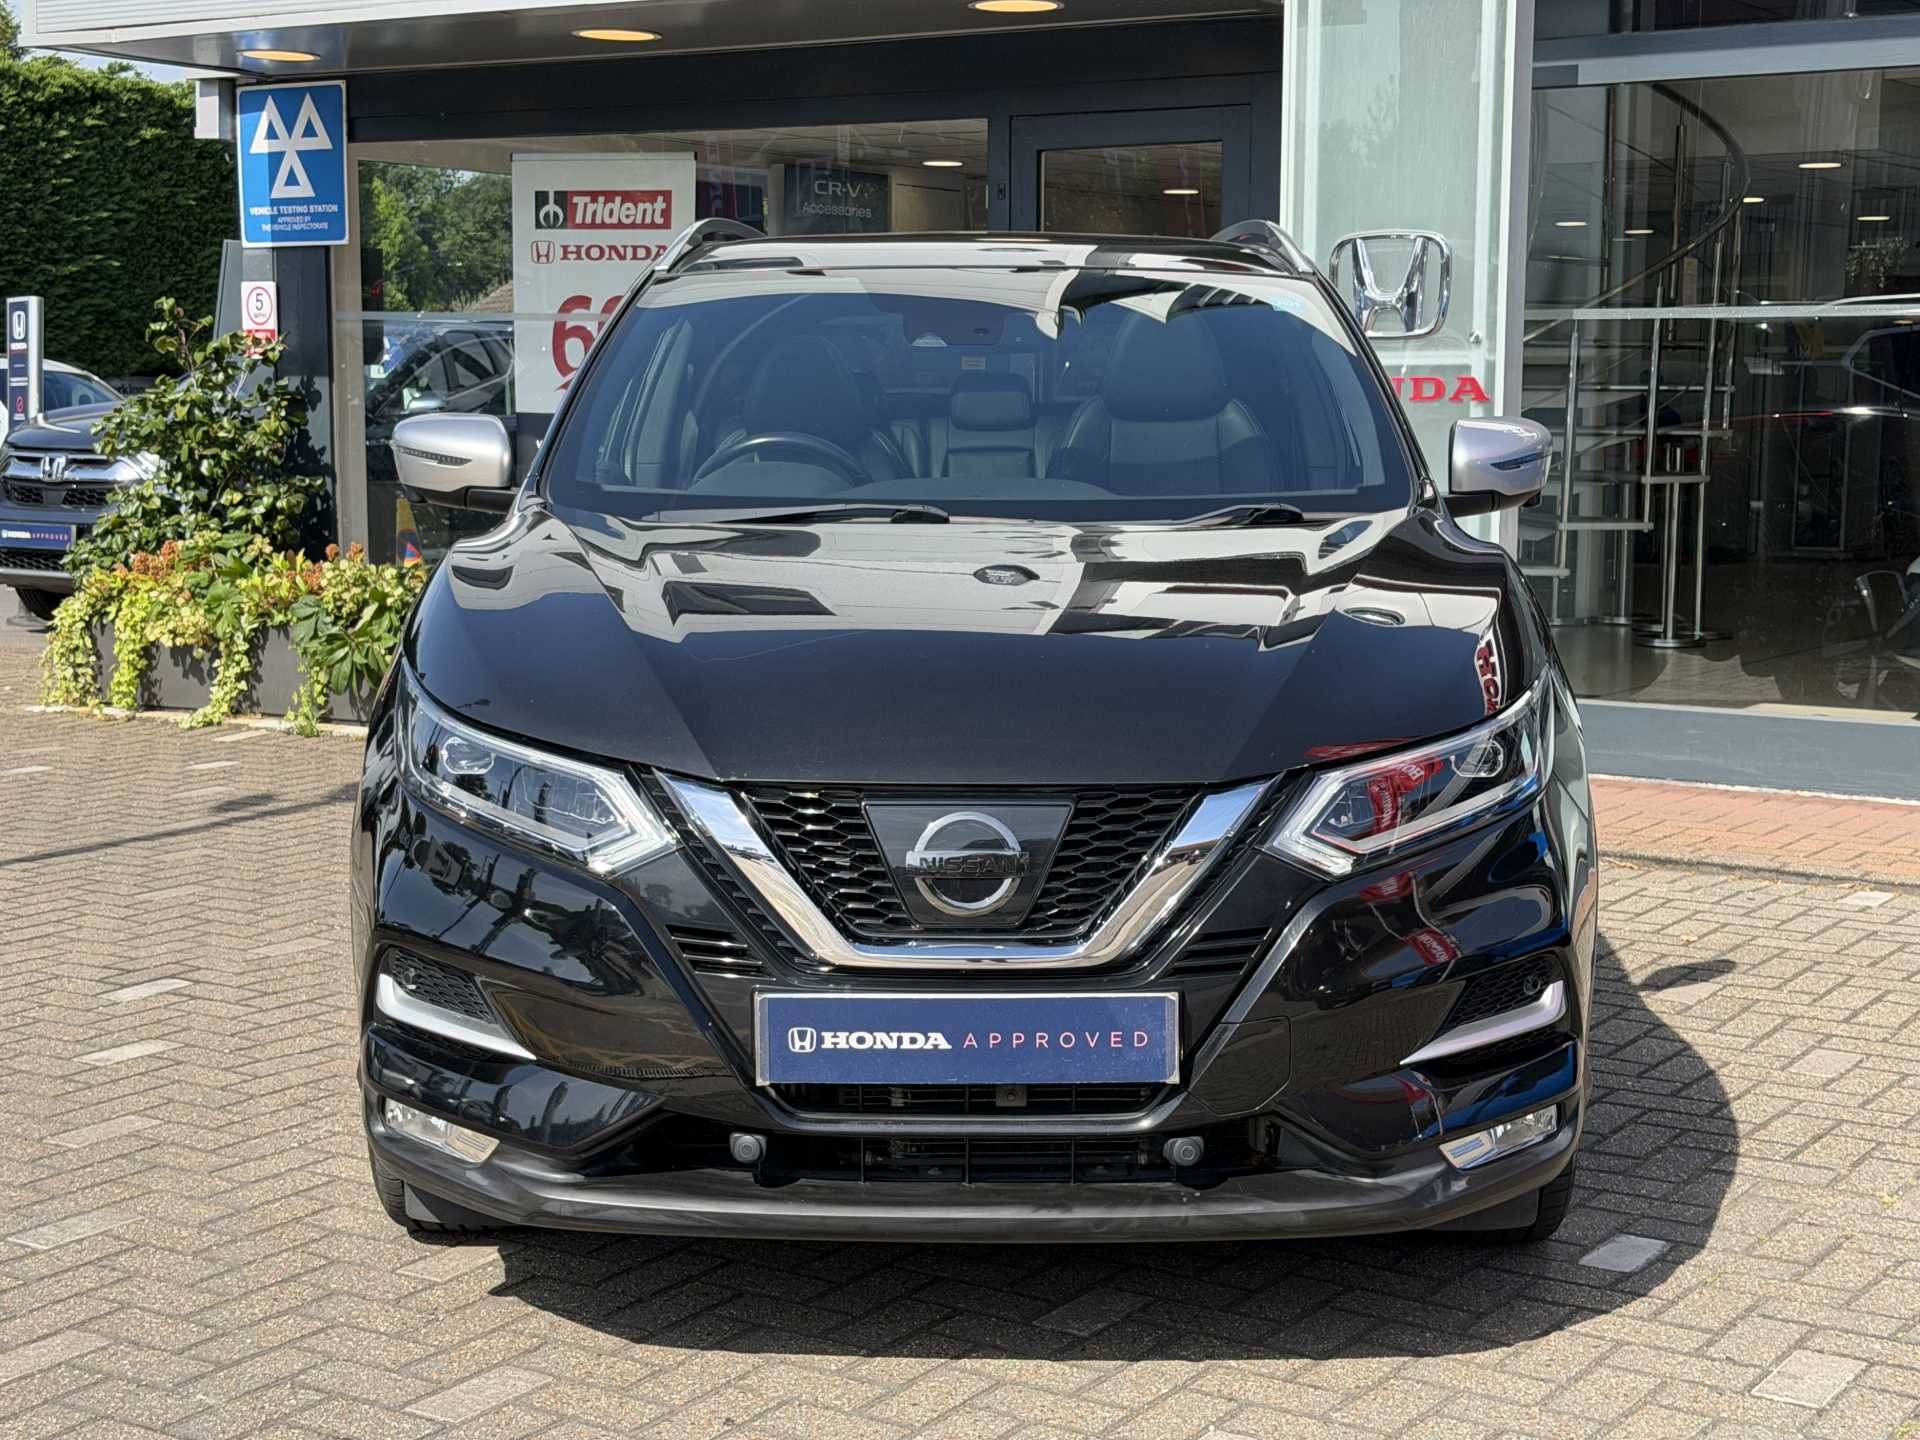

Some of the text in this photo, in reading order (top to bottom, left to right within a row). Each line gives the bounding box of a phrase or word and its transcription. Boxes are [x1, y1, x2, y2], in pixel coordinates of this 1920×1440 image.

[814, 179, 861, 198] CR-V
[250, 203, 338, 216] VEHICLE TESTING STATION
[572, 195, 667, 225] Trident
[802, 201, 873, 218] Accessories
[261, 223, 272, 232] THE
[278, 216, 304, 224] APPROVED
[255, 292, 264, 311] 5
[919, 855, 1017, 874] NISSAN
[821, 1031, 1148, 1050] HONDA APPROVED
